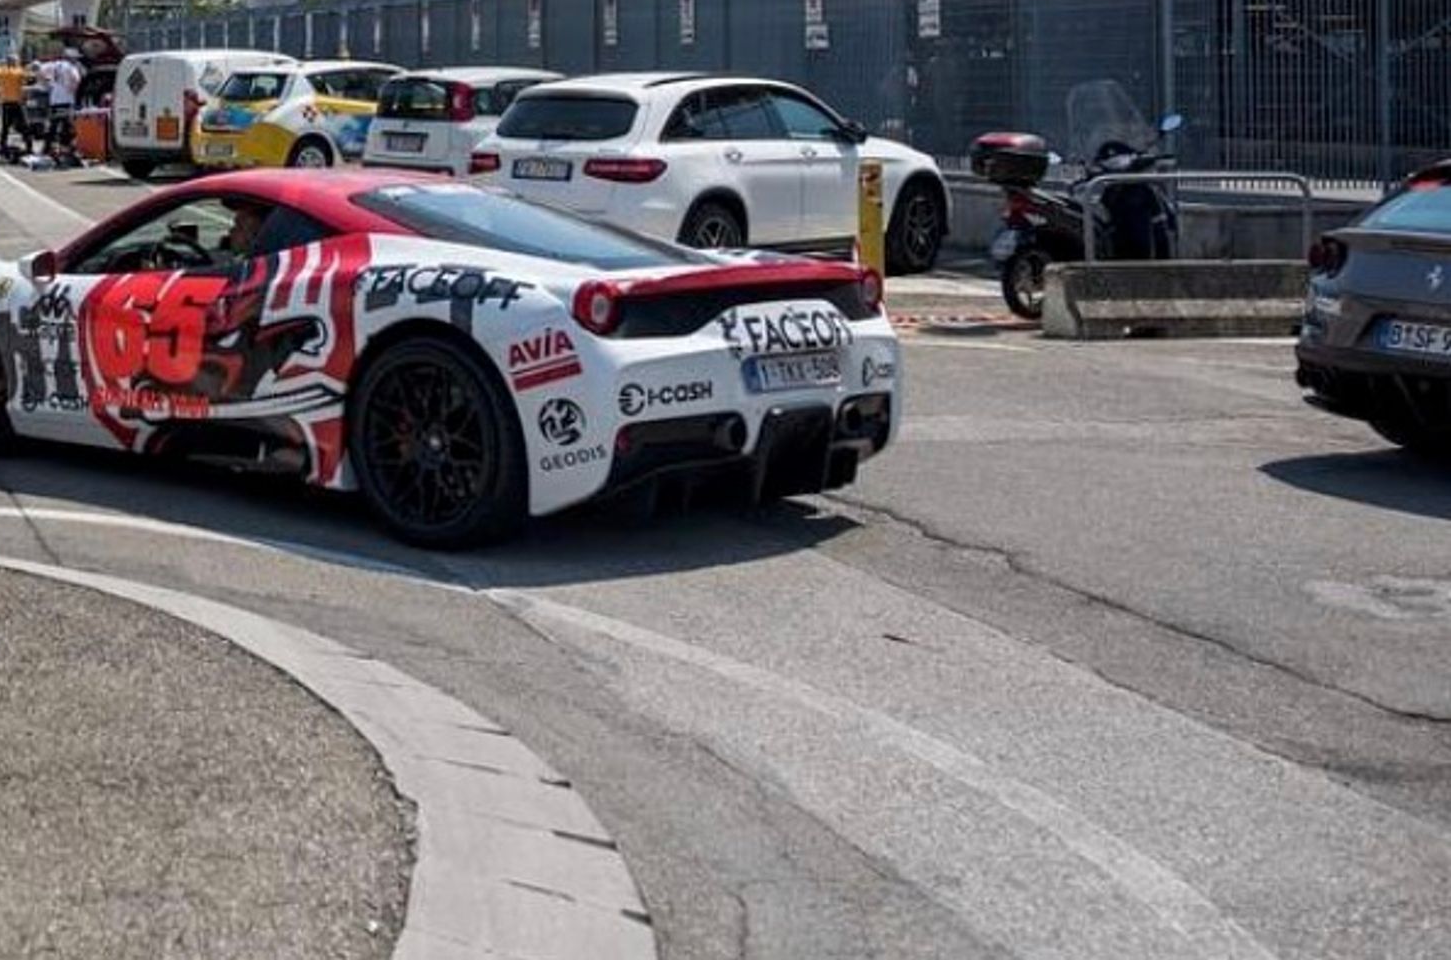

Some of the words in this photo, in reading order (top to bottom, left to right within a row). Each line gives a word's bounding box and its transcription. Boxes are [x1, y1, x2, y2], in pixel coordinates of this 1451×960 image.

[93, 271, 229, 384] 65
[509, 327, 575, 368] AVIA
[540, 444, 607, 471] GEODIS
